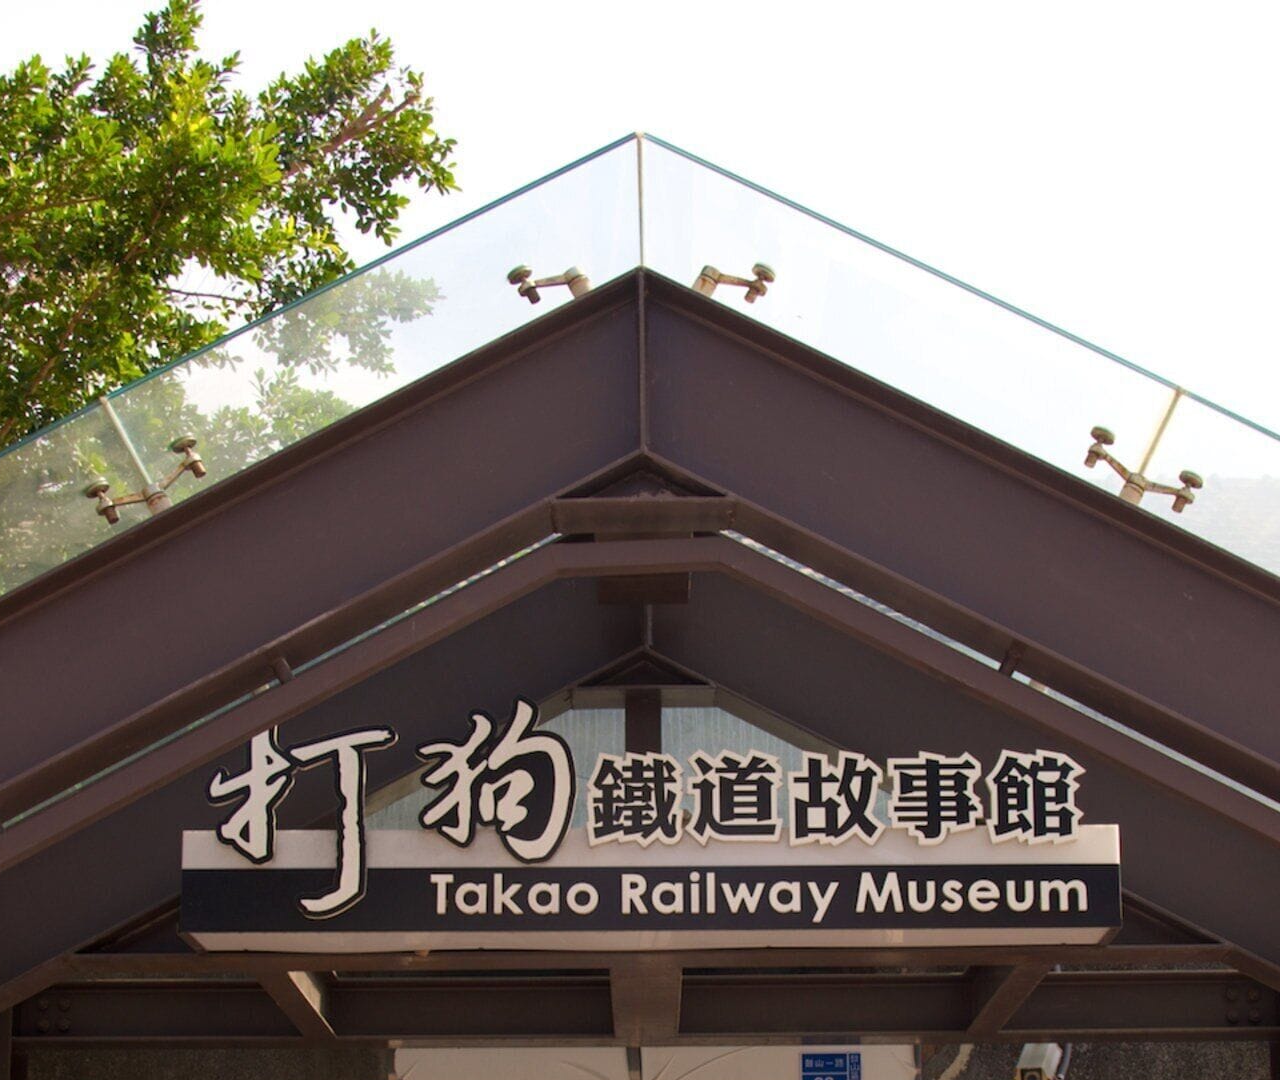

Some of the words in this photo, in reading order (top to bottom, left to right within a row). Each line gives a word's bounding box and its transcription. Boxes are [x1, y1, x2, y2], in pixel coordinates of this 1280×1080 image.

[208, 699, 1084, 921] 打狗鐵道故事館
[430, 873, 599, 915] Takao
[621, 872, 838, 924] Railway
[855, 871, 1088, 914] Museum
